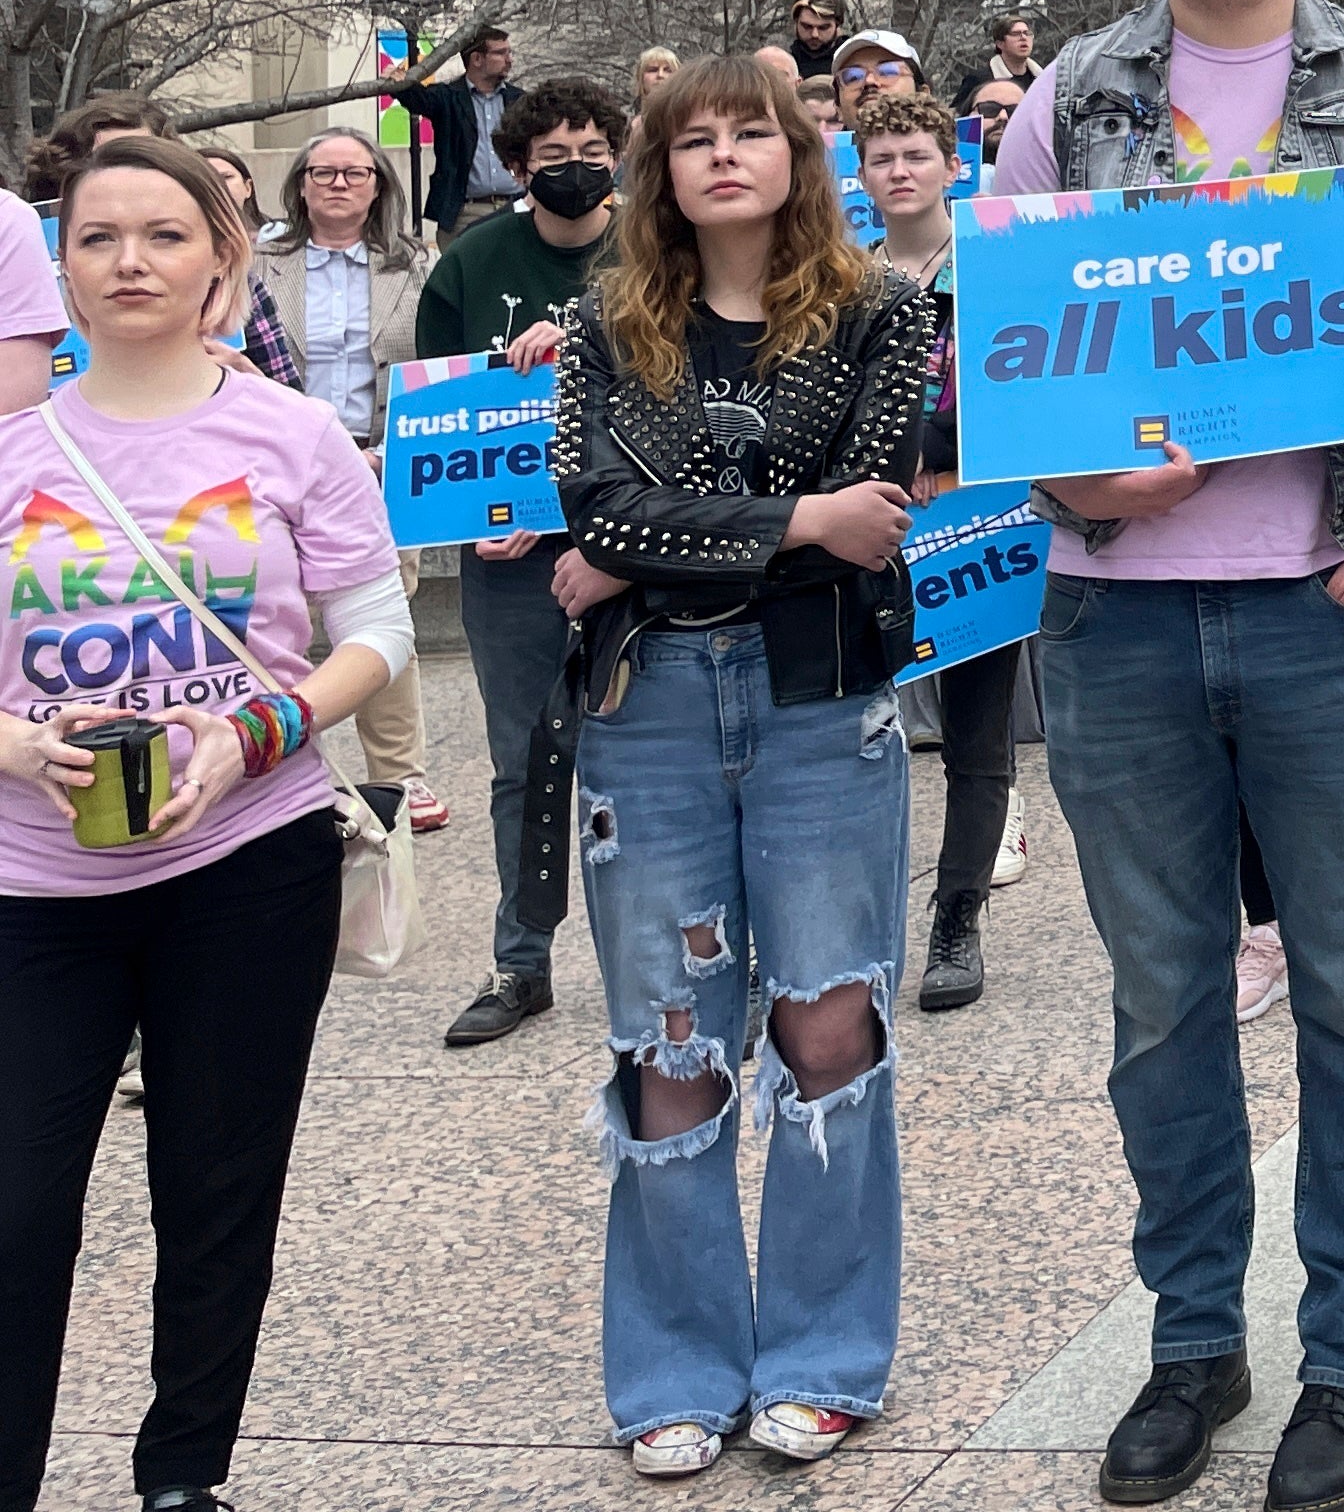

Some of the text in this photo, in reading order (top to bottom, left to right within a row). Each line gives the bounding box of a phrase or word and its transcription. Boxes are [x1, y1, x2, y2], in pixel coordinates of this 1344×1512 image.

[1072, 240, 1283, 289] care for
[983, 299, 1121, 383] all
[396, 407, 470, 439] trust
[1177, 404, 1237, 421] HUMAN
[1178, 418, 1238, 436] RIGHTS
[915, 542, 1039, 610] ents
[22, 605, 197, 695] CON
[119, 688, 150, 712] IS
[163, 671, 251, 708] LOVE
